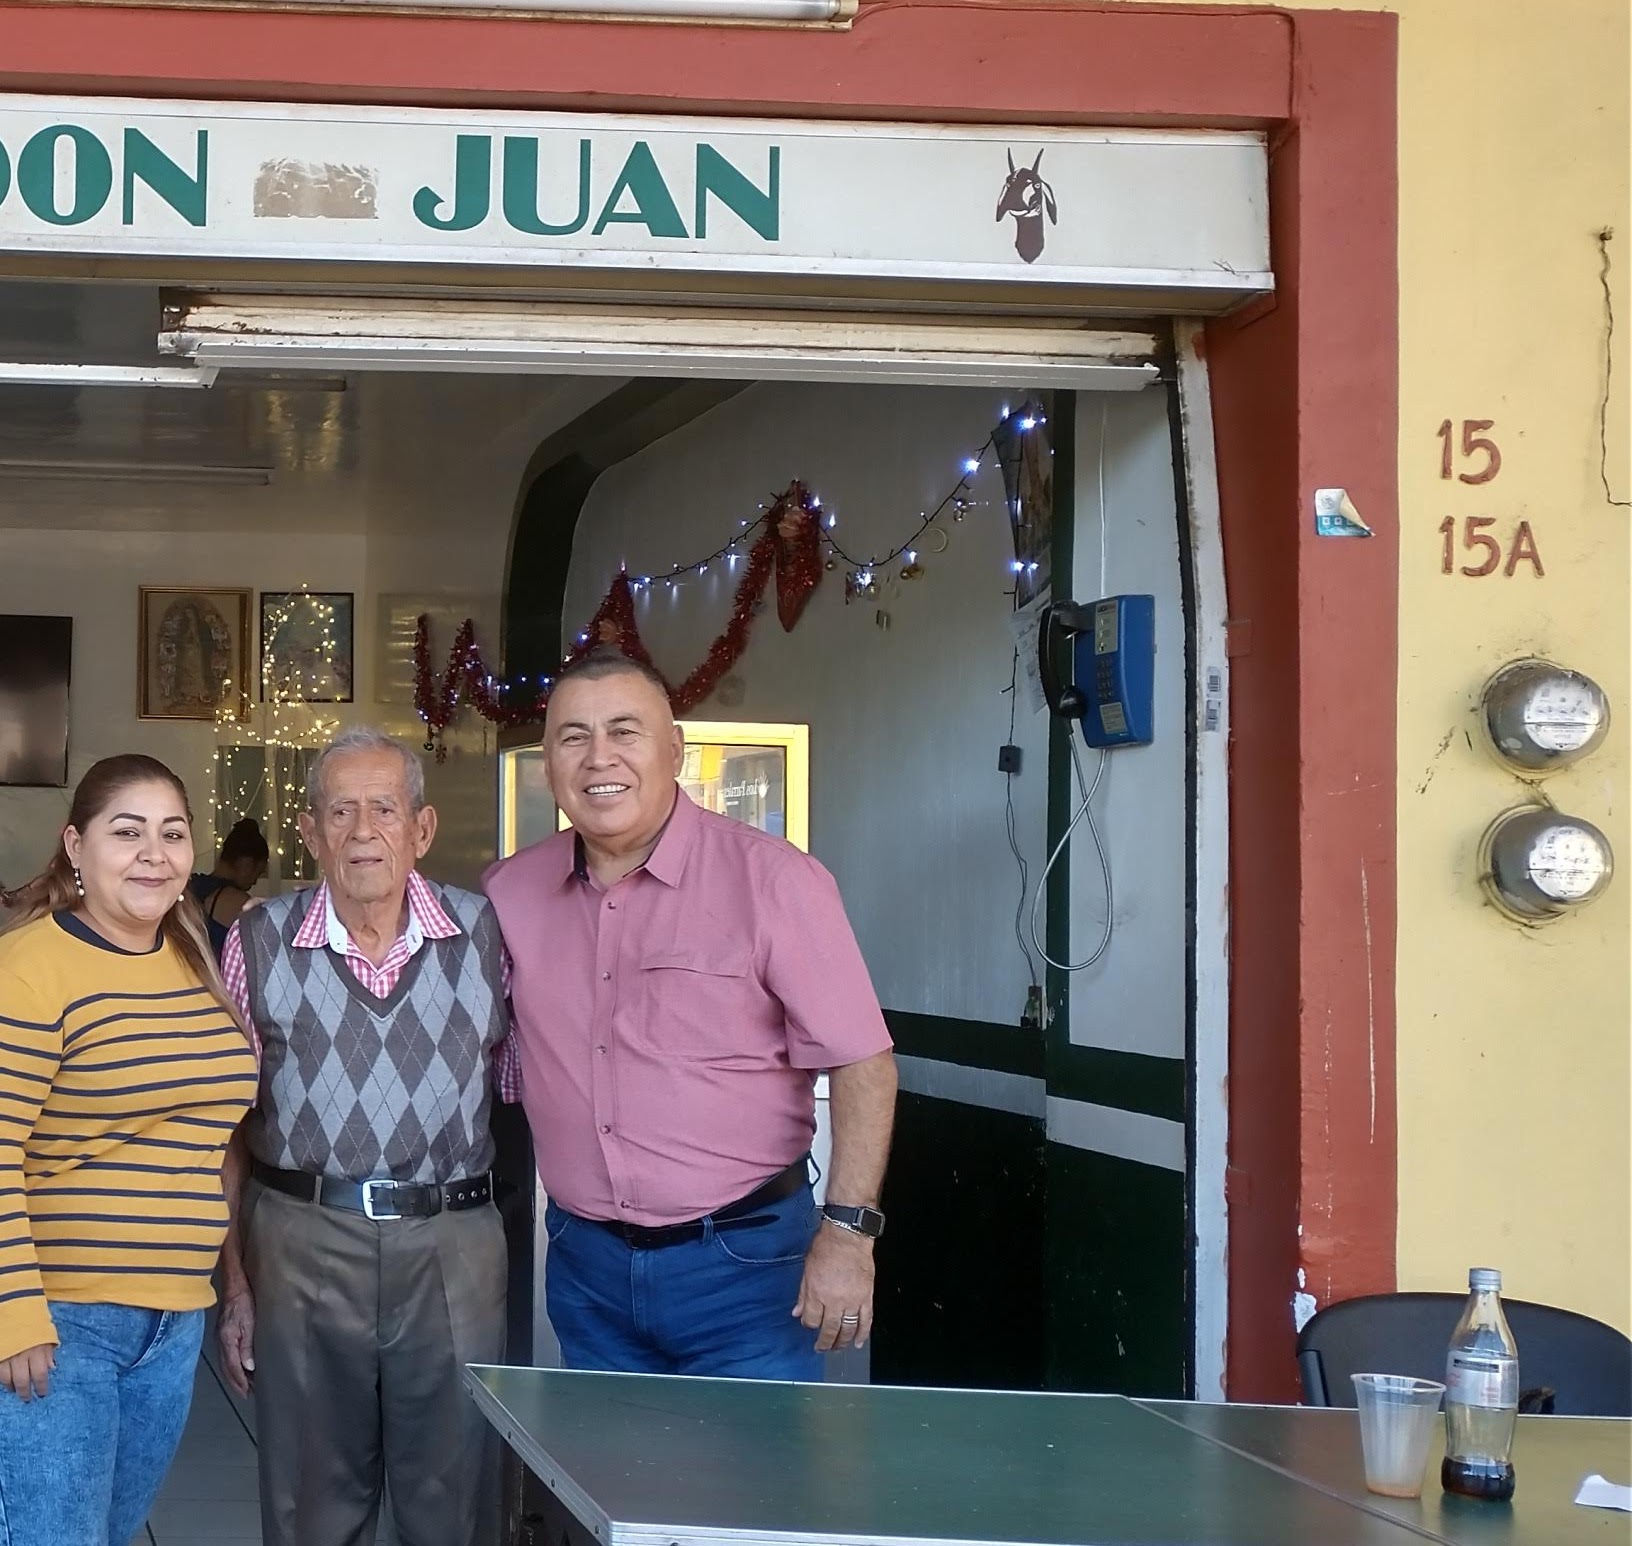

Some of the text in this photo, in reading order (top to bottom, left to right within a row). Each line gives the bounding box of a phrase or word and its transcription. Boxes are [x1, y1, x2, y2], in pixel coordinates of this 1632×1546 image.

[413, 134, 780, 241] JUAN
[1437, 418, 1502, 485] 15
[1439, 515, 1545, 577] 15A
